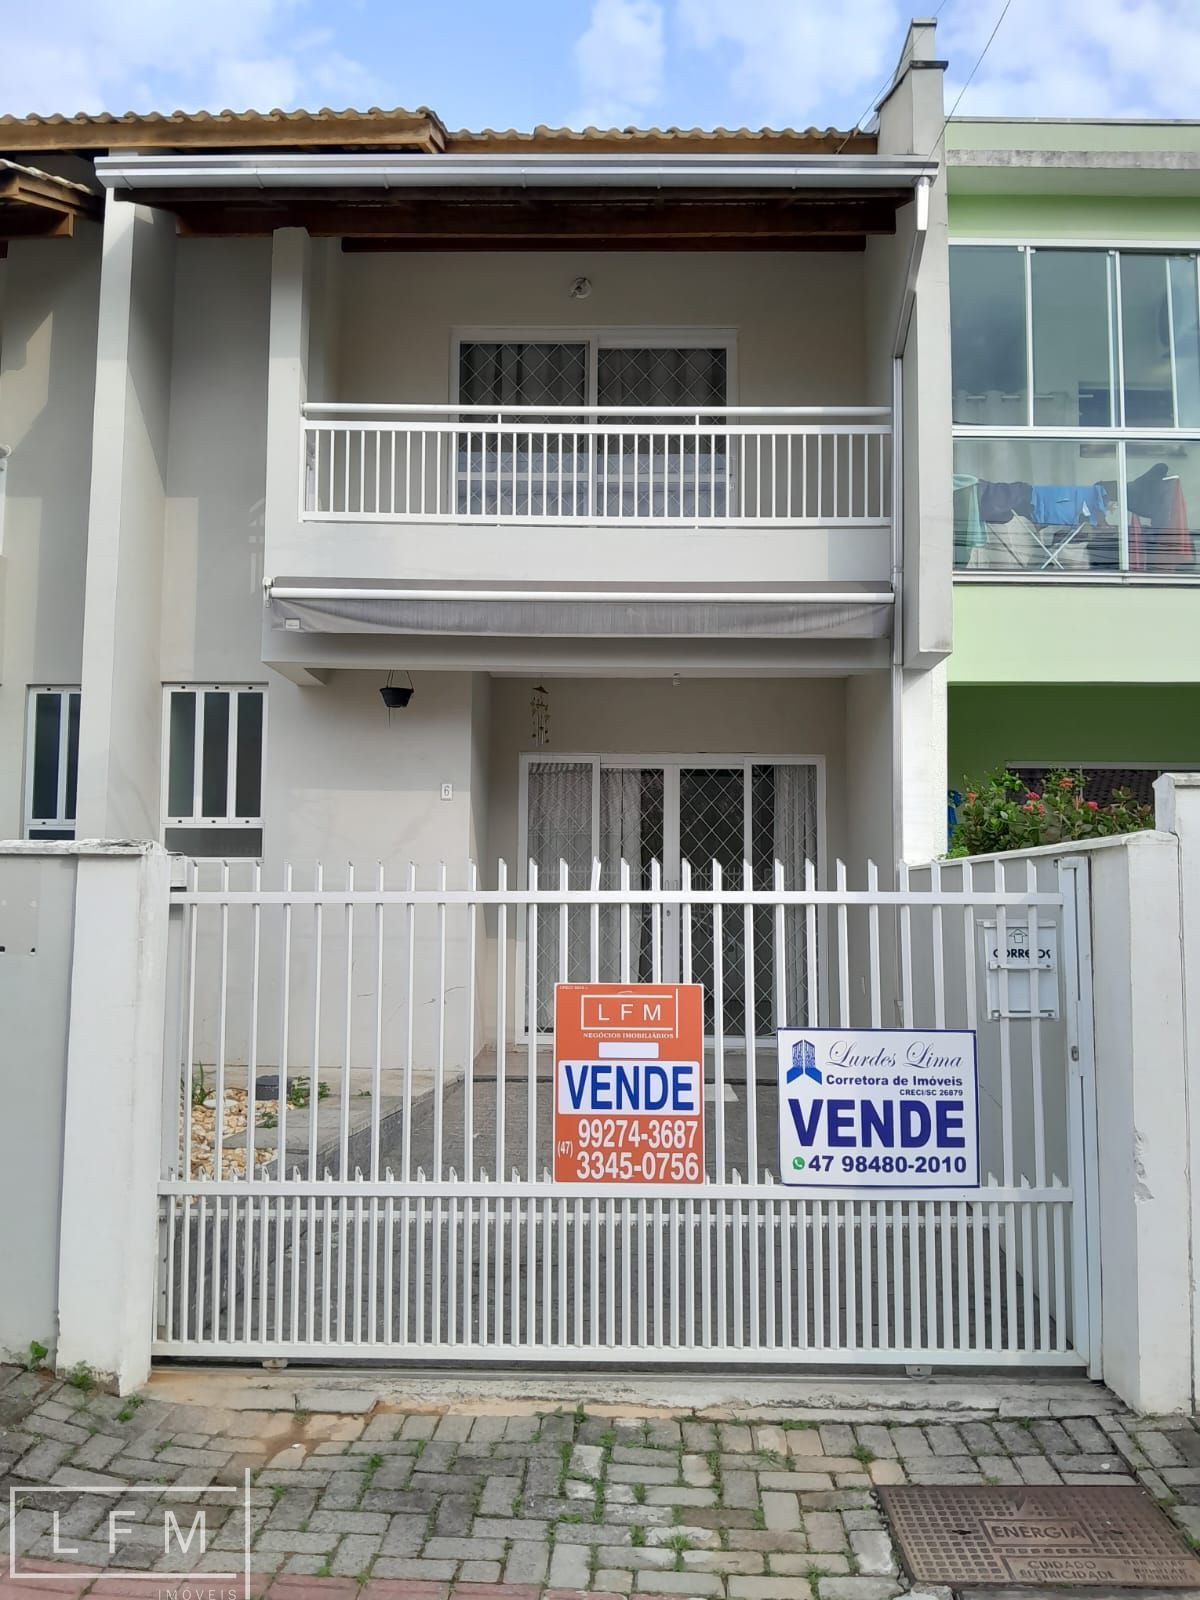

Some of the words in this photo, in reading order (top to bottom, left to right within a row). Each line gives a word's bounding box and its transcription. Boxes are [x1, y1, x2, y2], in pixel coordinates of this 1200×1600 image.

[583, 1031, 621, 1039] NEGÓCIOS
[622, 1031, 674, 1039] IMOBILIÁRIOS
[826, 1040, 896, 1069] Lurdes
[904, 1040, 962, 1069] Lima
[565, 1064, 695, 1111] VENDE
[826, 1074, 889, 1086] Corretora
[892, 1075, 909, 1086] de
[913, 1074, 963, 1087] Imóveis
[788, 1098, 966, 1149] VENDE
[578, 1118, 698, 1149] 99274-3687
[557, 1140, 574, 1158] (47)
[576, 1151, 699, 1181] 3345-0756
[808, 1155, 834, 1172] 47
[841, 1155, 967, 1173] 98480-2010
[991, 1525, 1087, 1540] ENERGIA
[1028, 1560, 1097, 1570] CUIDADO
